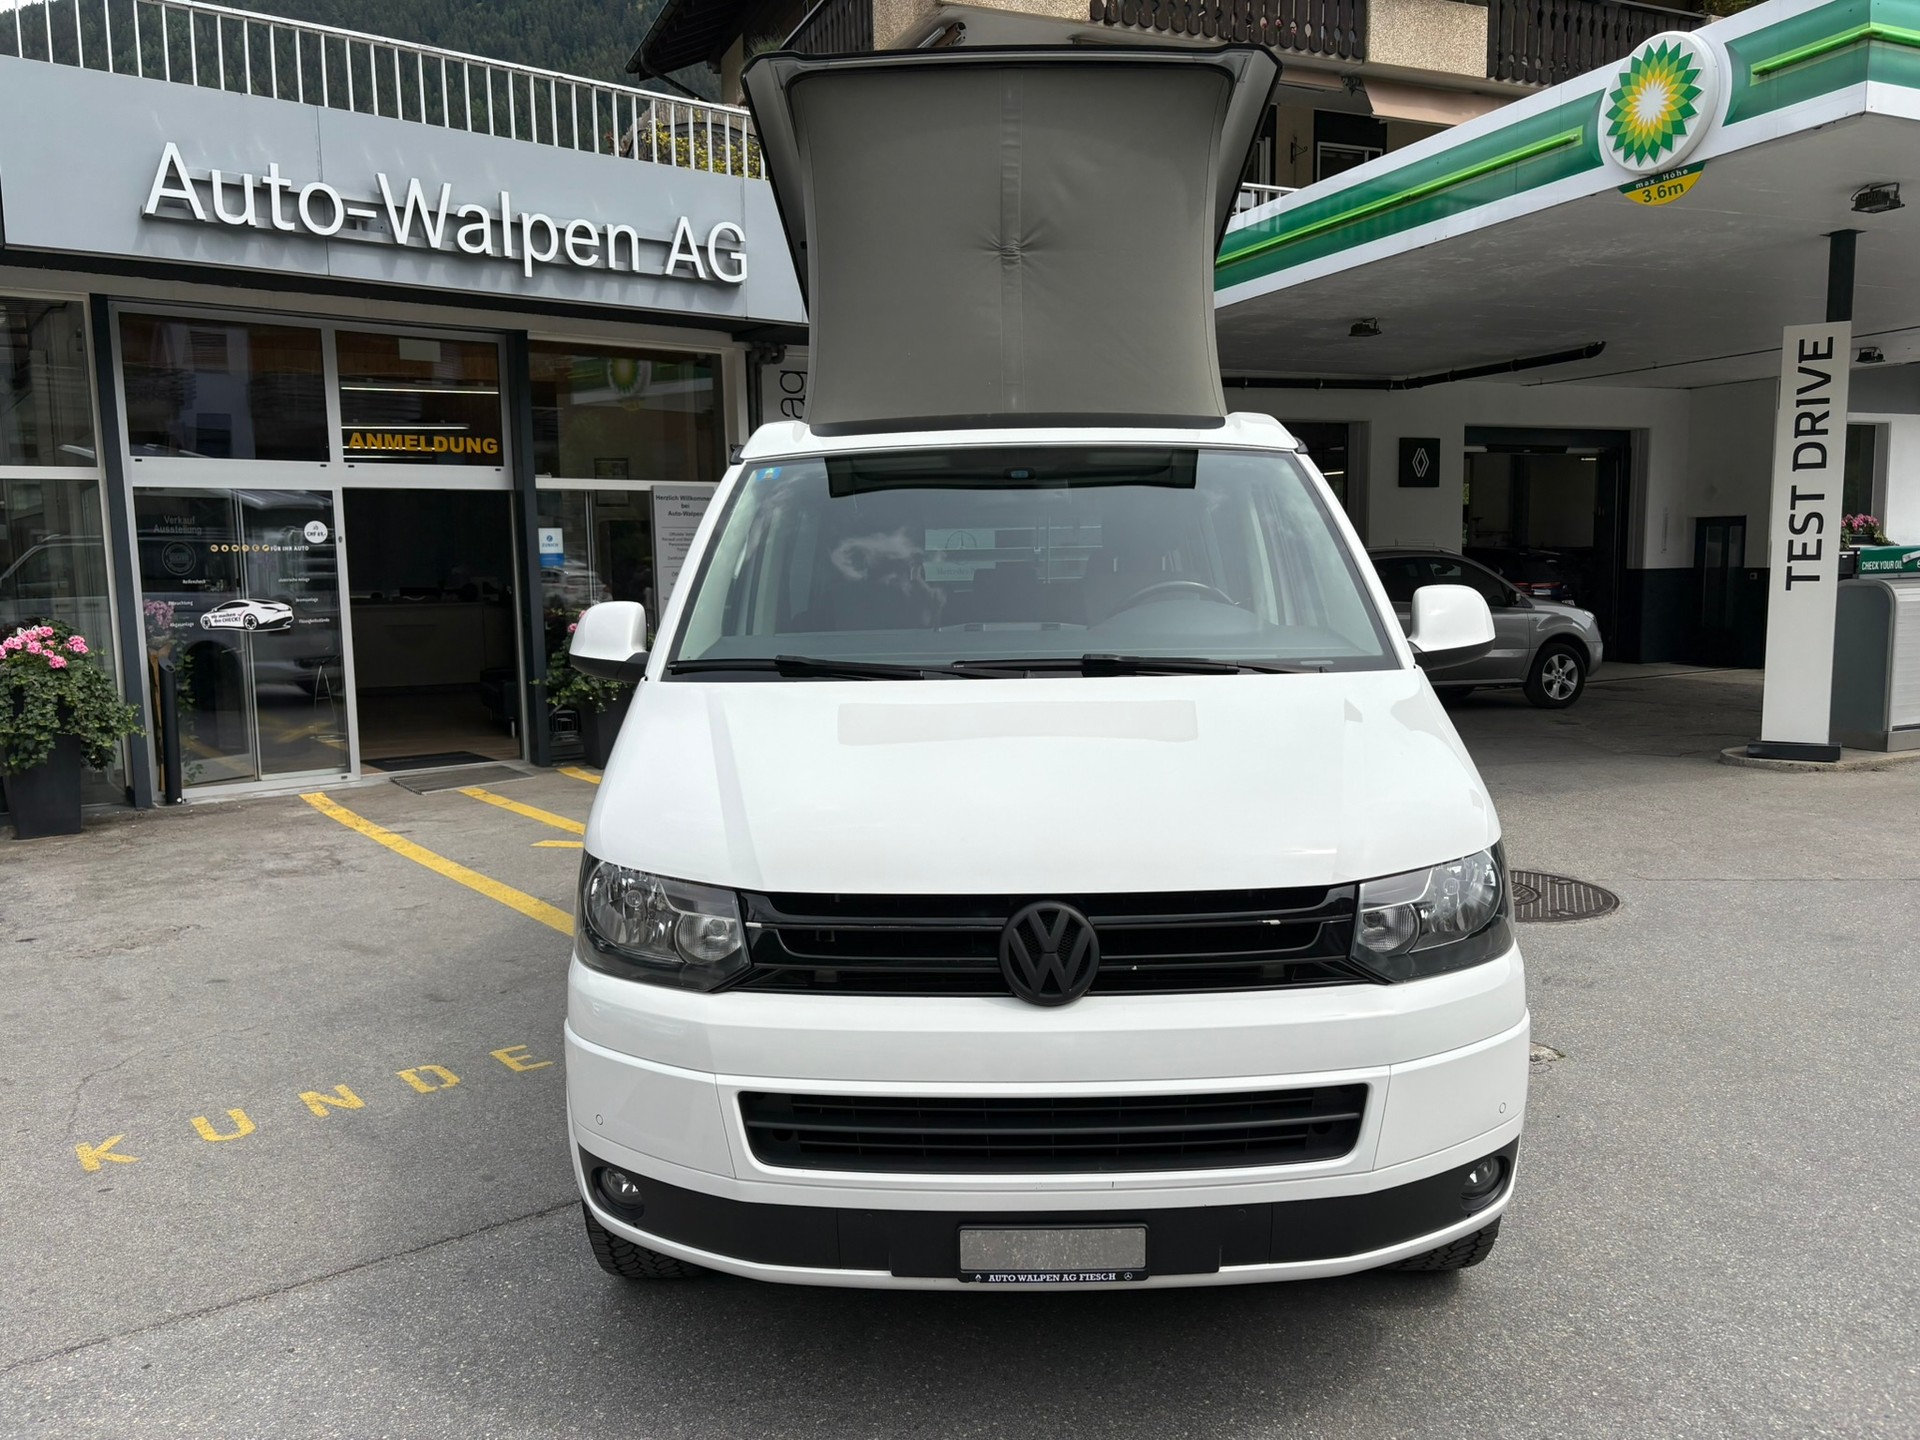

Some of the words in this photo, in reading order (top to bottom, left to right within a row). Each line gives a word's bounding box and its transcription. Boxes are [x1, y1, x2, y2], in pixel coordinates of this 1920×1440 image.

[1635, 179, 1659, 189] max.
[1662, 169, 1688, 181] Höhe
[1642, 183, 1684, 203] 3.6m
[141, 142, 640, 277] Auto-Walpen
[665, 215, 749, 285] AG
[1792, 336, 1834, 472] DRIVE
[349, 432, 498, 454] ANMELDUNG
[153, 524, 202, 535] Ausstellung
[163, 515, 196, 525] Verkauf
[1785, 485, 1825, 591] TEST
[1861, 561, 1879, 571] CHECK
[1880, 560, 1895, 570] YOUR
[1895, 560, 1903, 570] OIL
[1000, 901, 1100, 1007] VW
[75, 1044, 553, 1172] KUNDE
[988, 1274, 1016, 1282] AUTO
[1017, 1274, 1060, 1282] WALPEN
[1079, 1273, 1116, 1281] FIESCH
